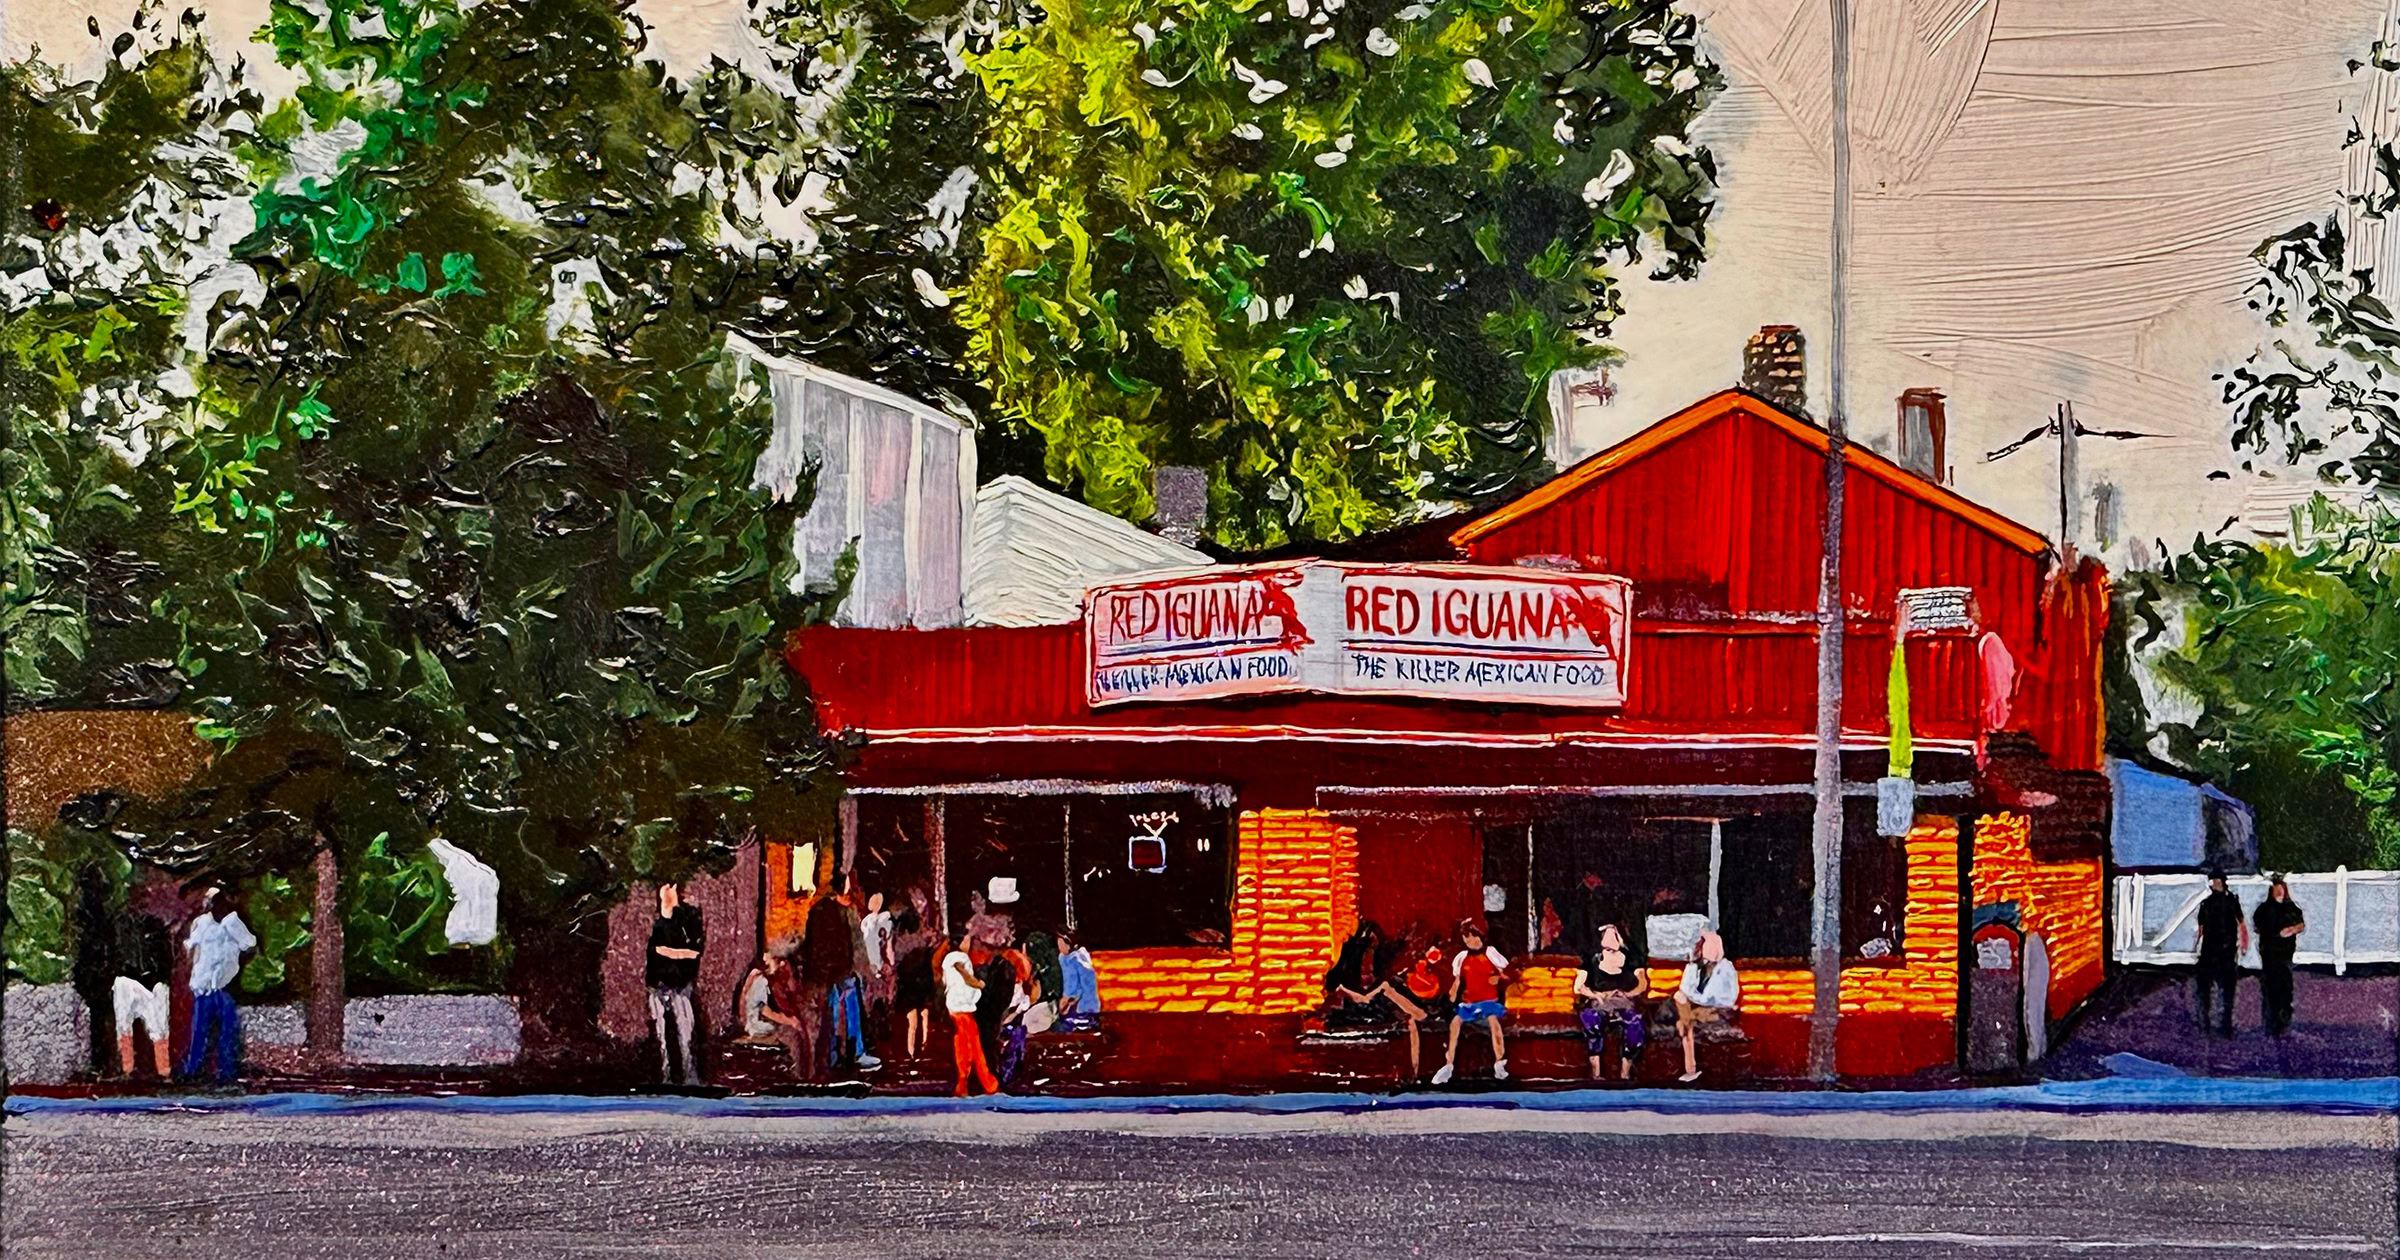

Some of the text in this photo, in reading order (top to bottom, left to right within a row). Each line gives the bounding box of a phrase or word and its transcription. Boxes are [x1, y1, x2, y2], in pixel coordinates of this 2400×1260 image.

[1110, 588, 1263, 645] RED IGUANA
[1345, 586, 1570, 642] RED IGUANA
[1248, 655, 1289, 678] FOOD
[1351, 652, 1605, 687] THE KILLER MEXICAN FOOD
